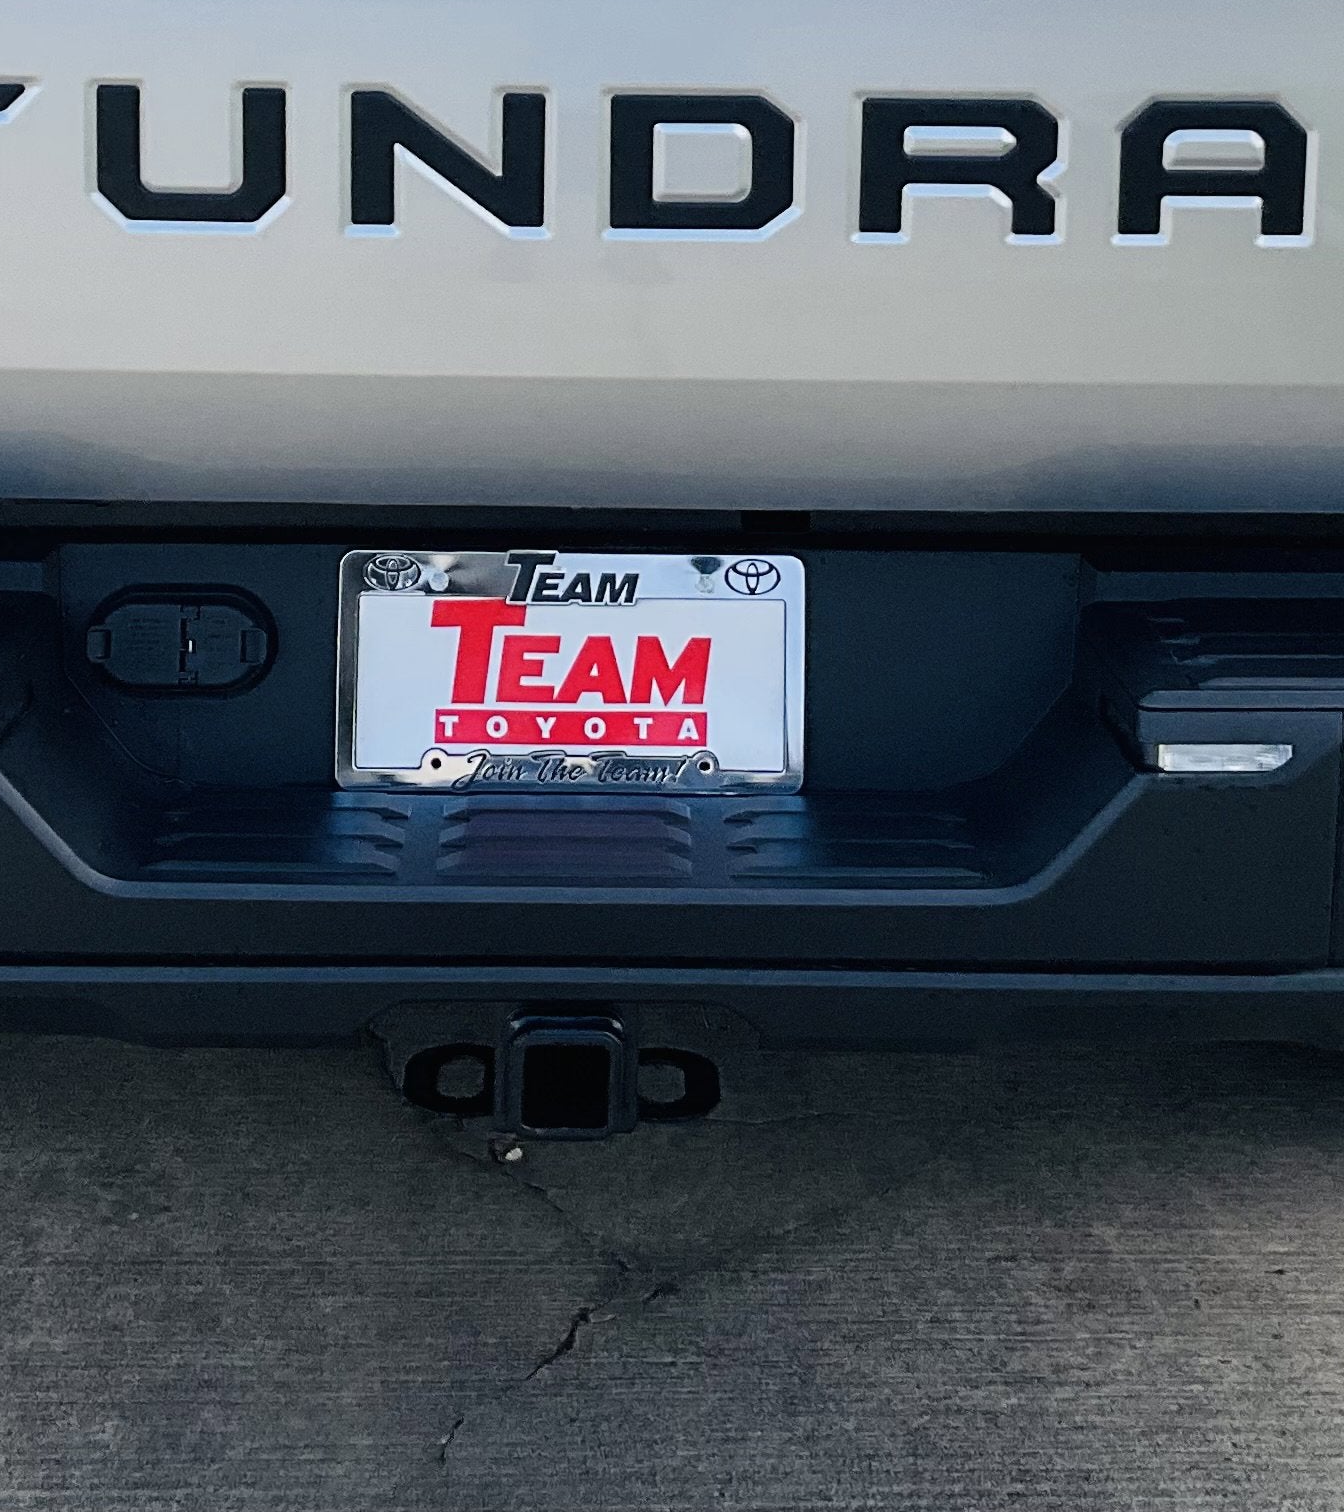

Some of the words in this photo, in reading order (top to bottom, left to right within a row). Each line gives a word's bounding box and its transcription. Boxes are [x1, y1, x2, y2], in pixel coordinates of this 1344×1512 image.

[506, 551, 640, 605] TEAM
[430, 598, 713, 706] TEAM
[438, 714, 701, 742] TOYOTA
[452, 752, 526, 790] Join
[532, 751, 585, 784] The
[589, 751, 688, 785] Team!
